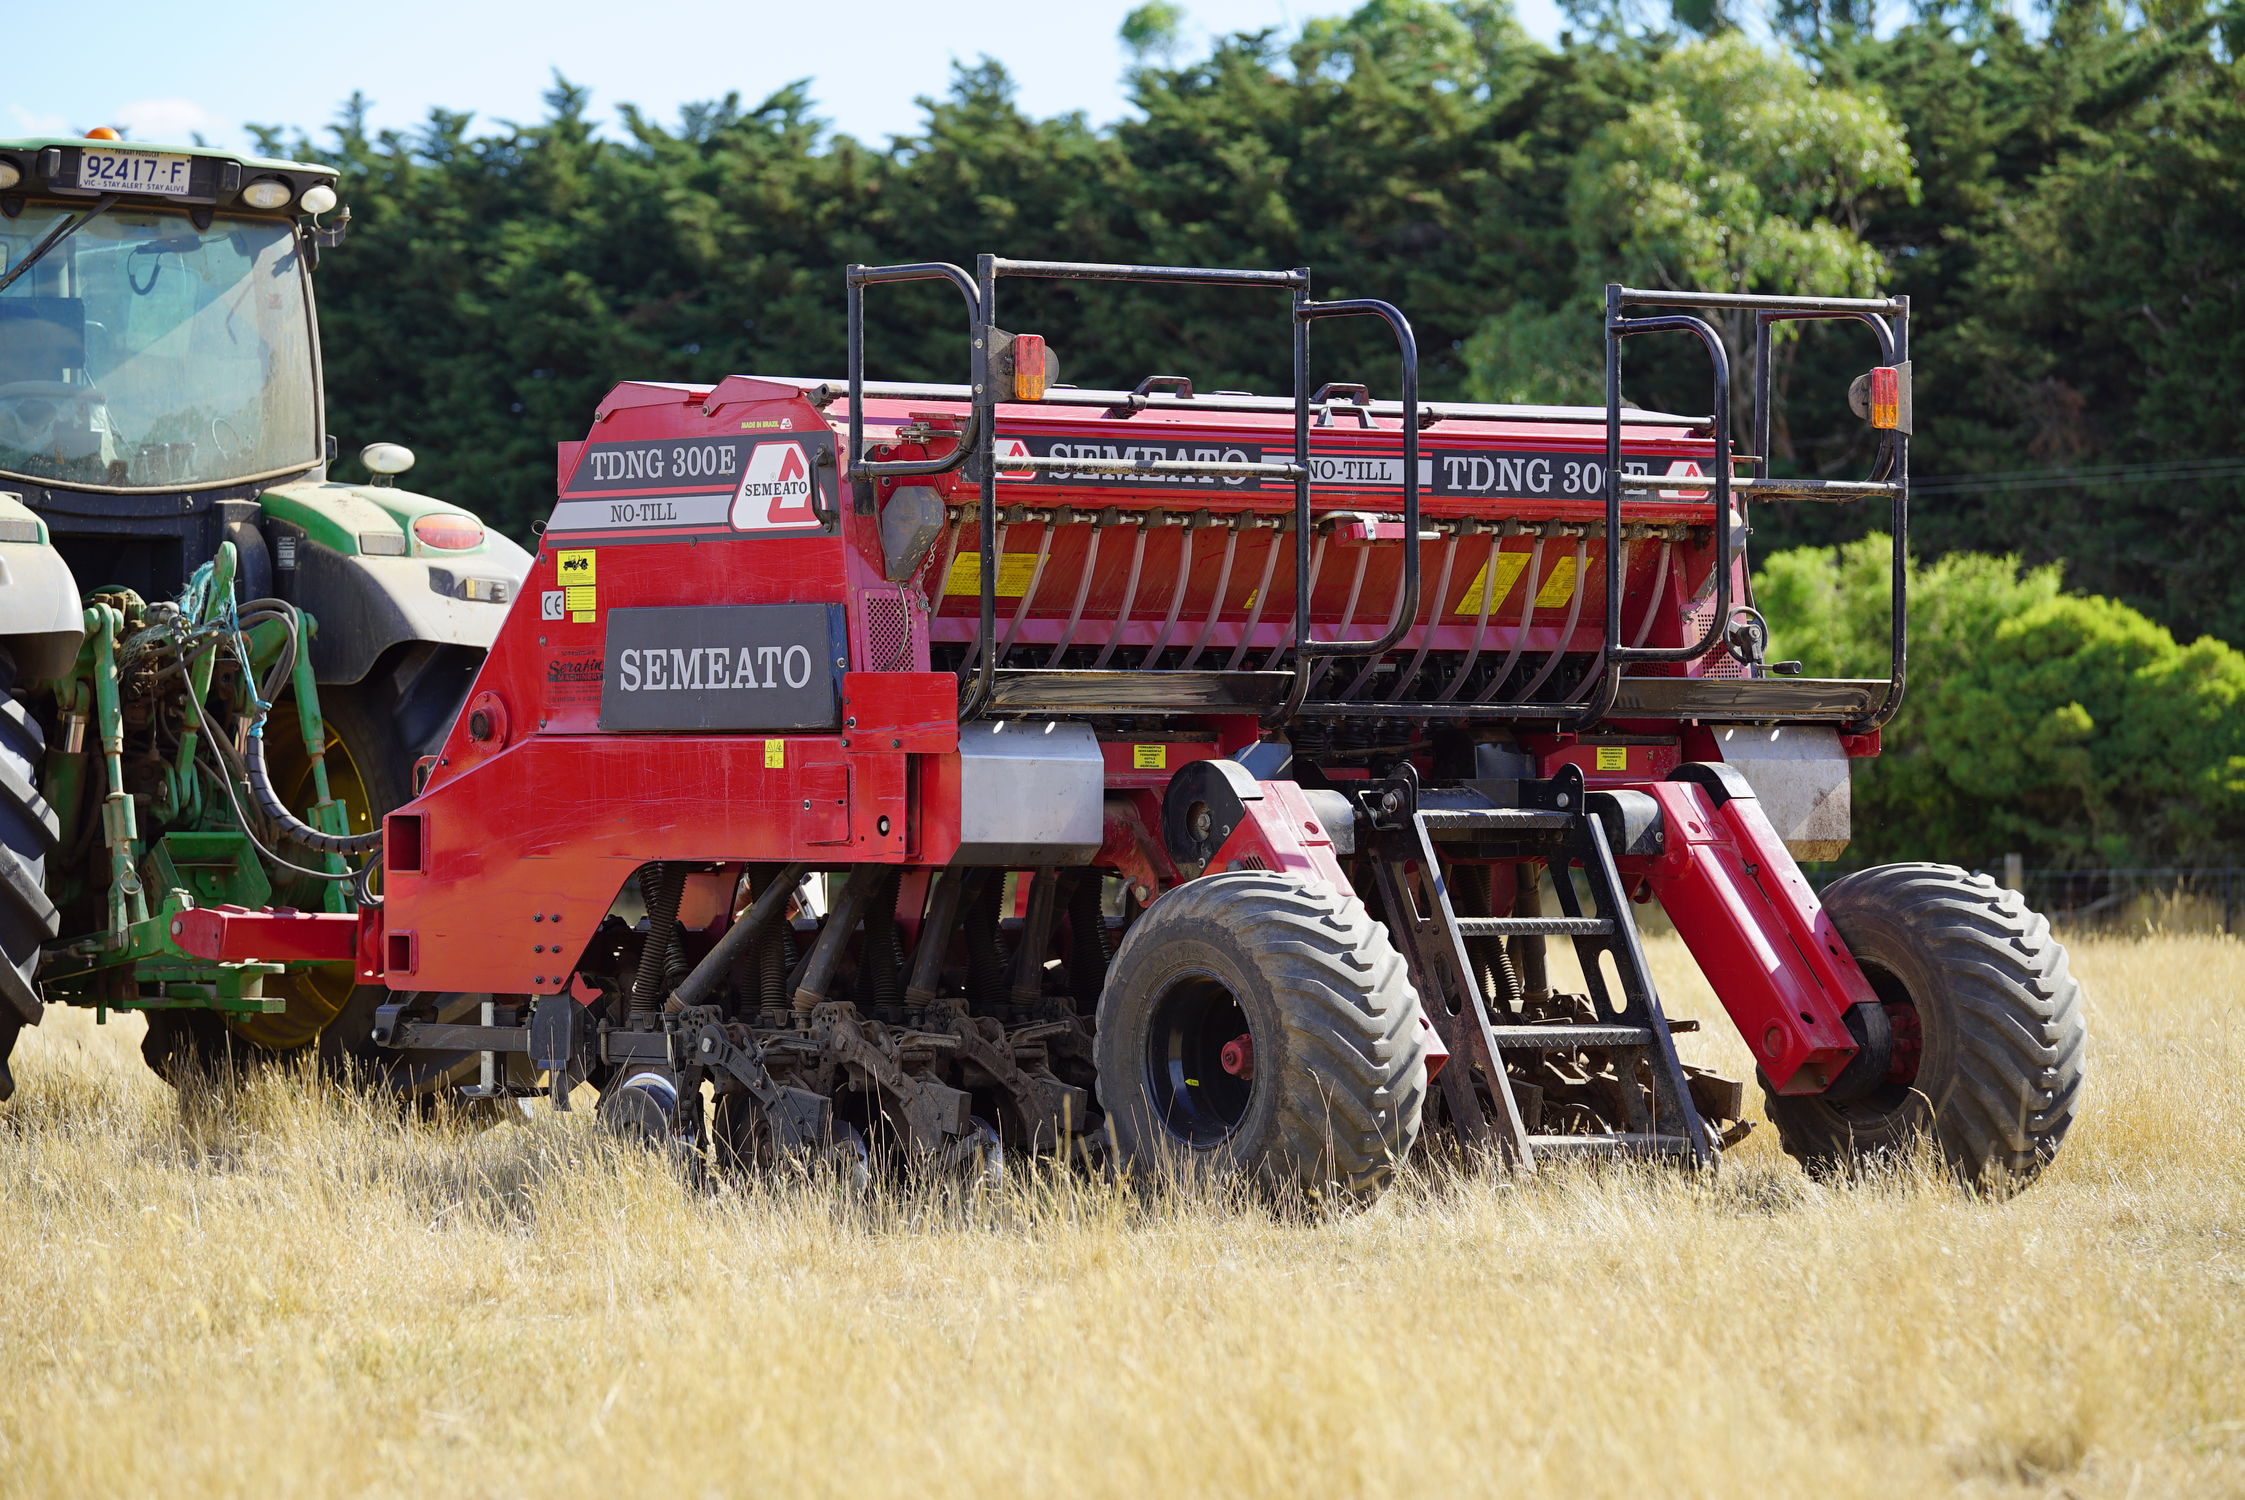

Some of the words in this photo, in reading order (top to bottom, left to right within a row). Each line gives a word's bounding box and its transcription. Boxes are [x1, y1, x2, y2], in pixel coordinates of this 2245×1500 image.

[591, 449, 665, 480] TDNG
[672, 445, 736, 477] 300E
[1049, 443, 1249, 485] SEMEATO
[1309, 460, 1392, 480] NO-TILL
[1443, 456, 1553, 493] TDNG
[1562, 462, 1648, 495] 30E
[745, 481, 808, 497] SEMEATO
[610, 503, 677, 522] NO-TILL
[544, 595, 562, 616] CE
[620, 645, 812, 692] SEMEATO
